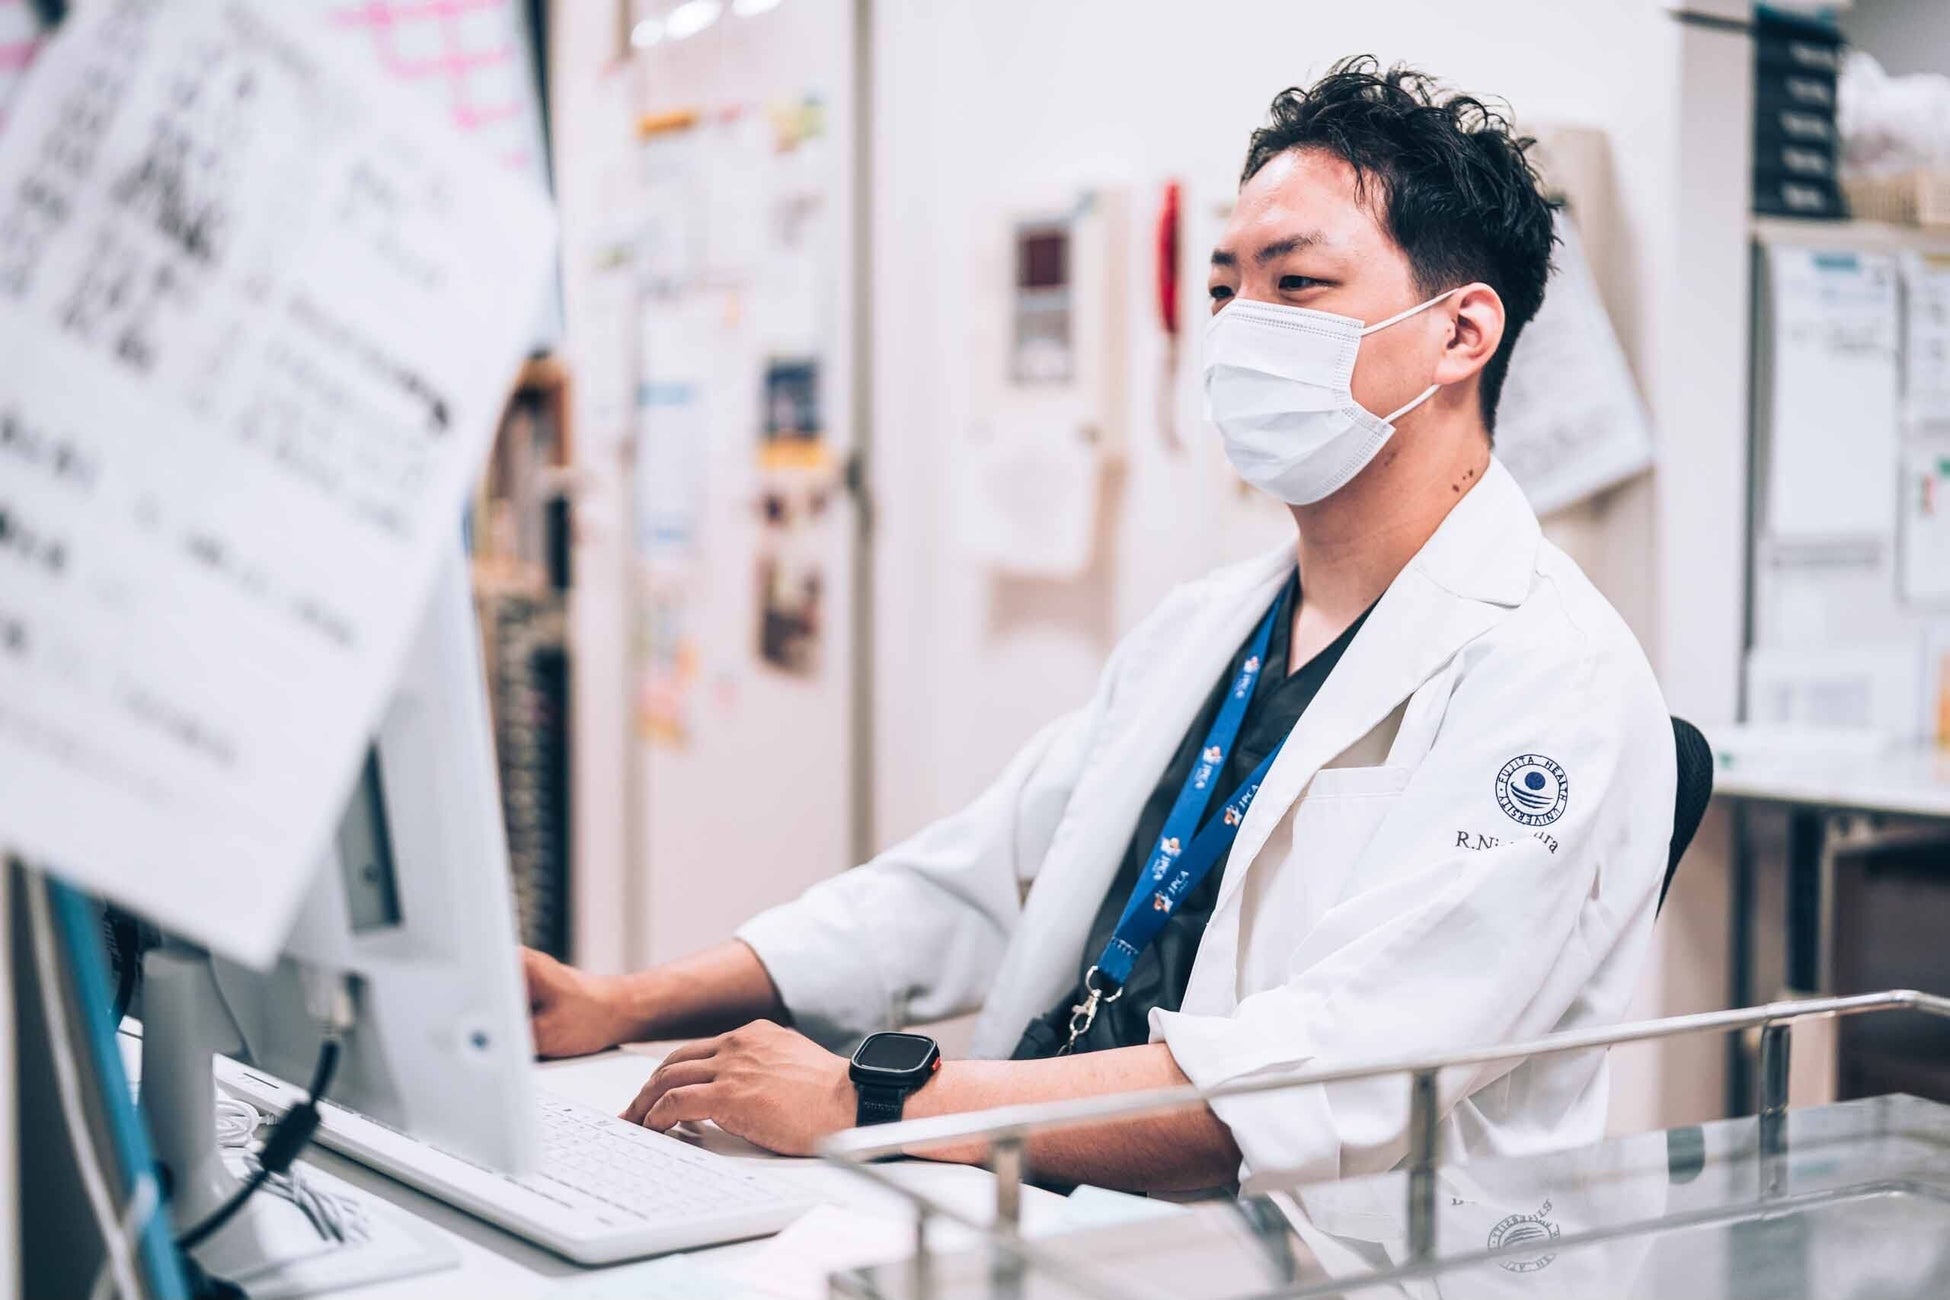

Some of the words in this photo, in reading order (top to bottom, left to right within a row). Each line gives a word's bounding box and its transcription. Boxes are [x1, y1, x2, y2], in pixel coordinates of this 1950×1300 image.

[1499, 756, 1534, 783] FUJITA
[1545, 760, 1567, 802] HEALTH
[1499, 796, 1560, 825] UNIVERSITY
